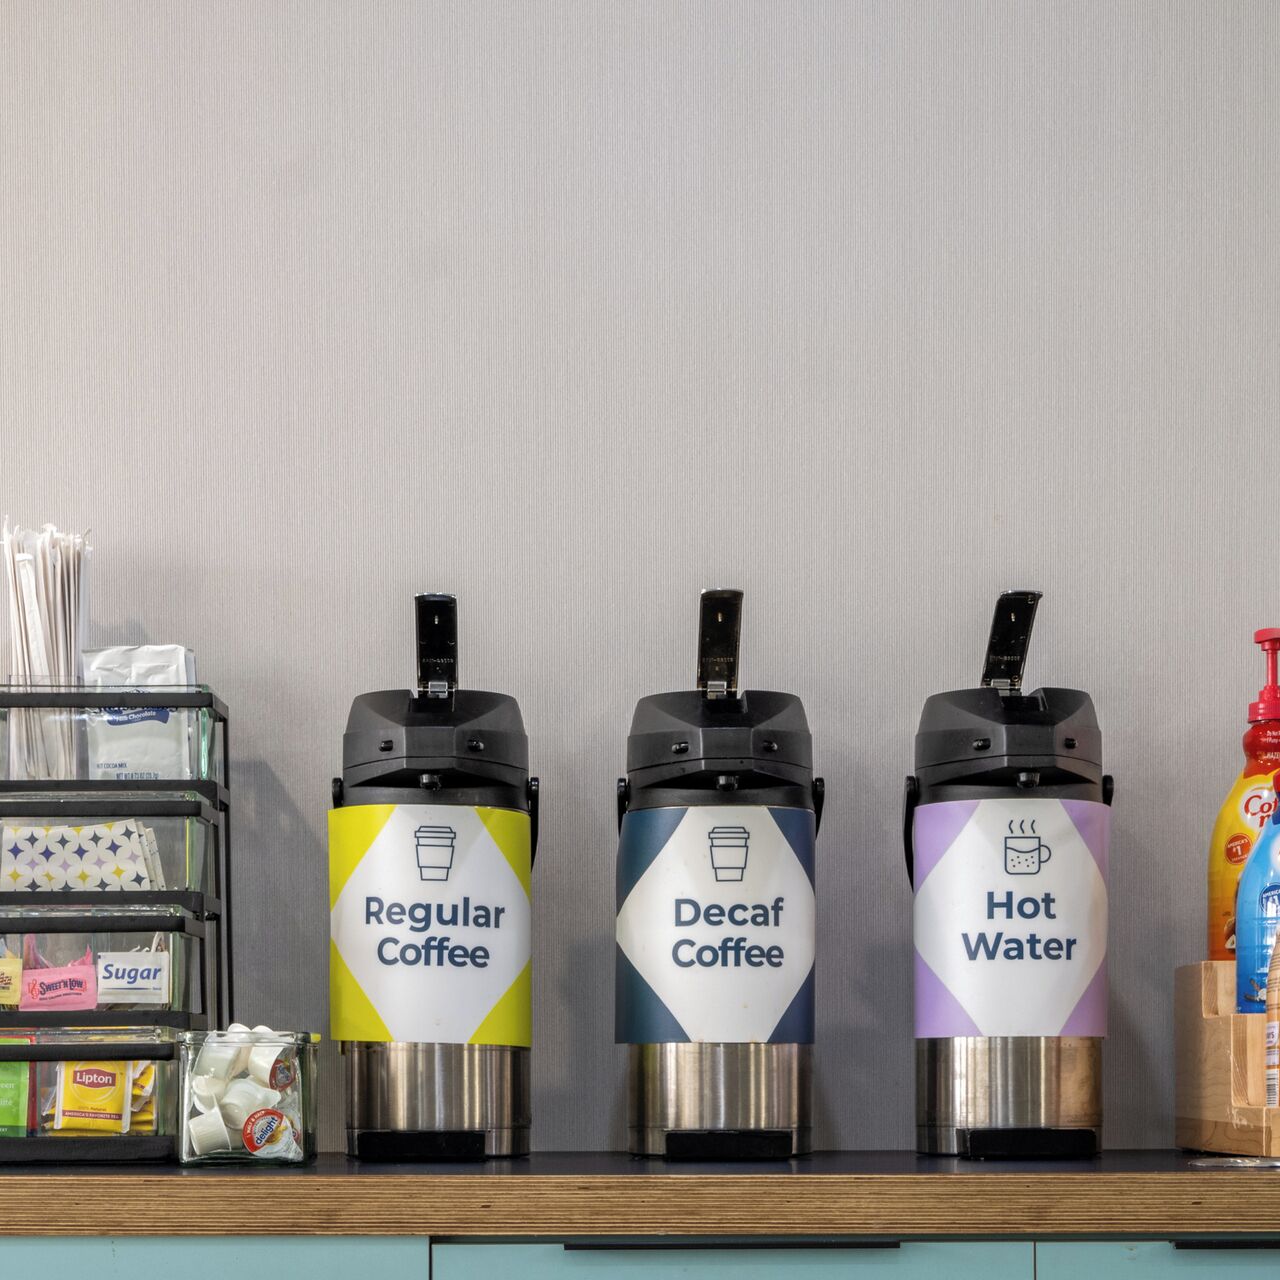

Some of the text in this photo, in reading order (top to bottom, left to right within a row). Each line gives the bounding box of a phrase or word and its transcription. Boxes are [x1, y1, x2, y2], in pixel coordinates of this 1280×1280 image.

[365, 895, 506, 933] Regular
[675, 896, 785, 927] Decaf
[988, 892, 1057, 920] Hot
[377, 936, 490, 969] Coffee
[672, 937, 785, 968] Coffee
[963, 932, 1077, 961] Water
[102, 964, 162, 984] Sugar
[76, 1072, 112, 1084] Lipton
[255, 1116, 278, 1145] delight
